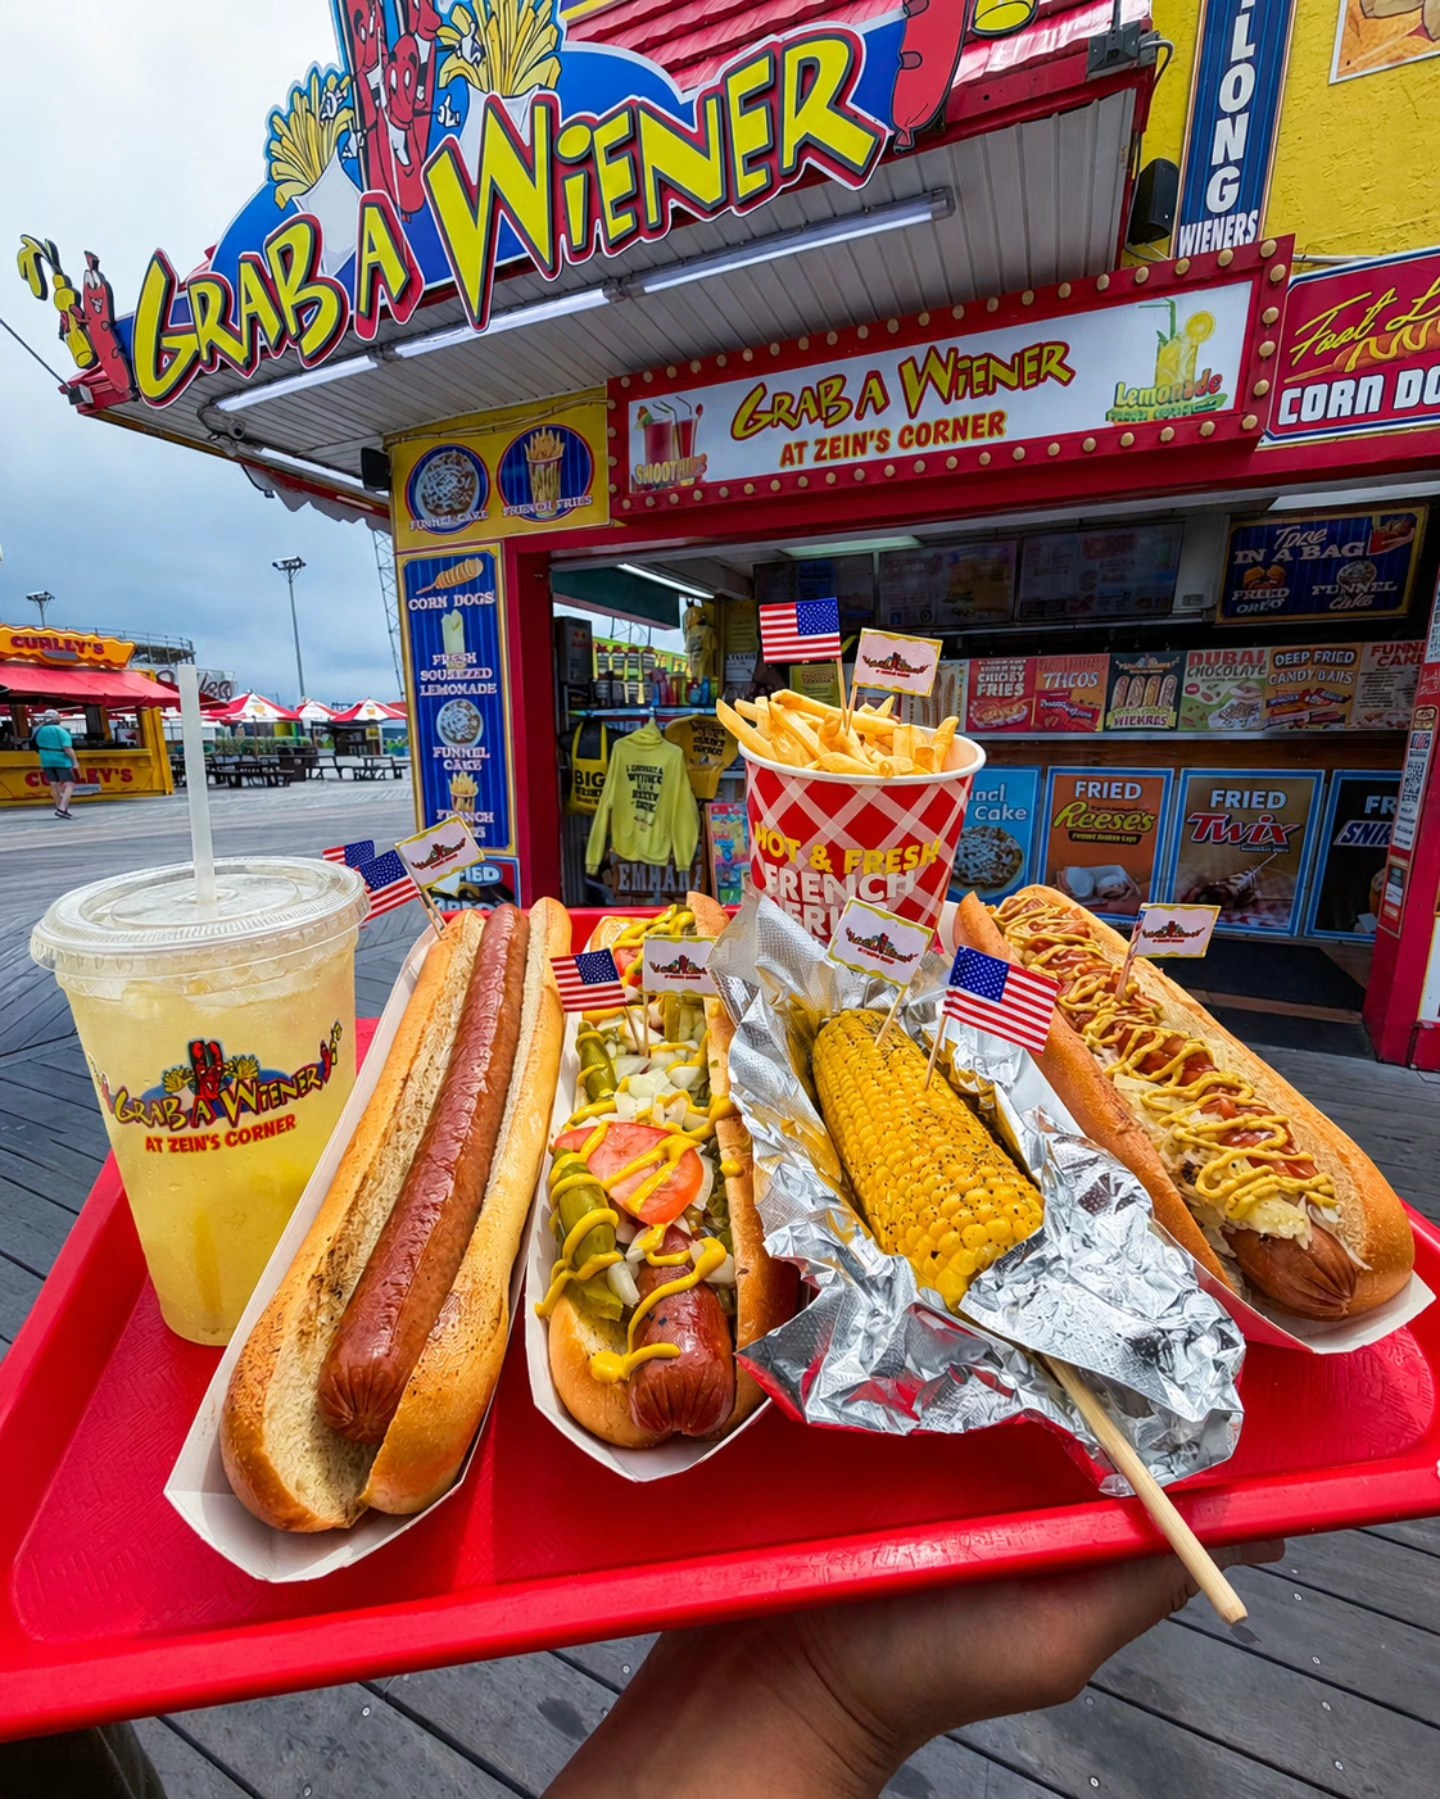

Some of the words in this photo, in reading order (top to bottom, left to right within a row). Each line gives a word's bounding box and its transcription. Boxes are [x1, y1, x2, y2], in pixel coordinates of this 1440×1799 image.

[1206, 13, 1256, 214] LONG
[1178, 209, 1259, 258] WIENERS
[133, 217, 347, 404] GRAB
[356, 191, 423, 338] A
[731, 375, 853, 440] GRAB
[855, 371, 890, 420] A
[1277, 374, 1385, 426] CORN
[779, 441, 808, 468] AT
[813, 428, 892, 463] ZEIN'S
[897, 410, 1008, 449] CORNER
[556, 494, 593, 510] FRIES
[1232, 549, 1267, 565] IN
[1272, 547, 1294, 562] A
[1300, 542, 1365, 560] BAG
[408, 595, 449, 611] CORN
[453, 591, 496, 607] DOGS
[1232, 588, 1290, 601] FRIED
[1188, 651, 1265, 668] DUBAI
[1274, 651, 1310, 666] DEEP
[1314, 650, 1355, 665] FRIED
[1268, 668, 1314, 685] CANDY
[419, 683, 497, 696] LEMONADE
[976, 683, 1025, 697] FRIES
[433, 746, 491, 759] FUNNEL
[443, 759, 482, 771] CAKE
[25, 768, 133, 788] CULEY'S
[574, 769, 606, 788] BIG
[1074, 780, 1142, 800] FRIED
[1210, 790, 1287, 809] FRIED
[435, 809, 495, 823] FNCH
[974, 804, 1028, 821] Cake
[754, 821, 801, 864] HOT
[809, 844, 834, 873] &
[844, 837, 942, 877] FRESH
[461, 866, 500, 882] IED
[764, 862, 916, 905] FRENCH
[114, 1085, 187, 1131] GRAB
[188, 1095, 217, 1128] A
[145, 1135, 164, 1153] AT
[168, 1132, 221, 1153] ZEIN'S
[224, 1113, 297, 1148] CORNER
